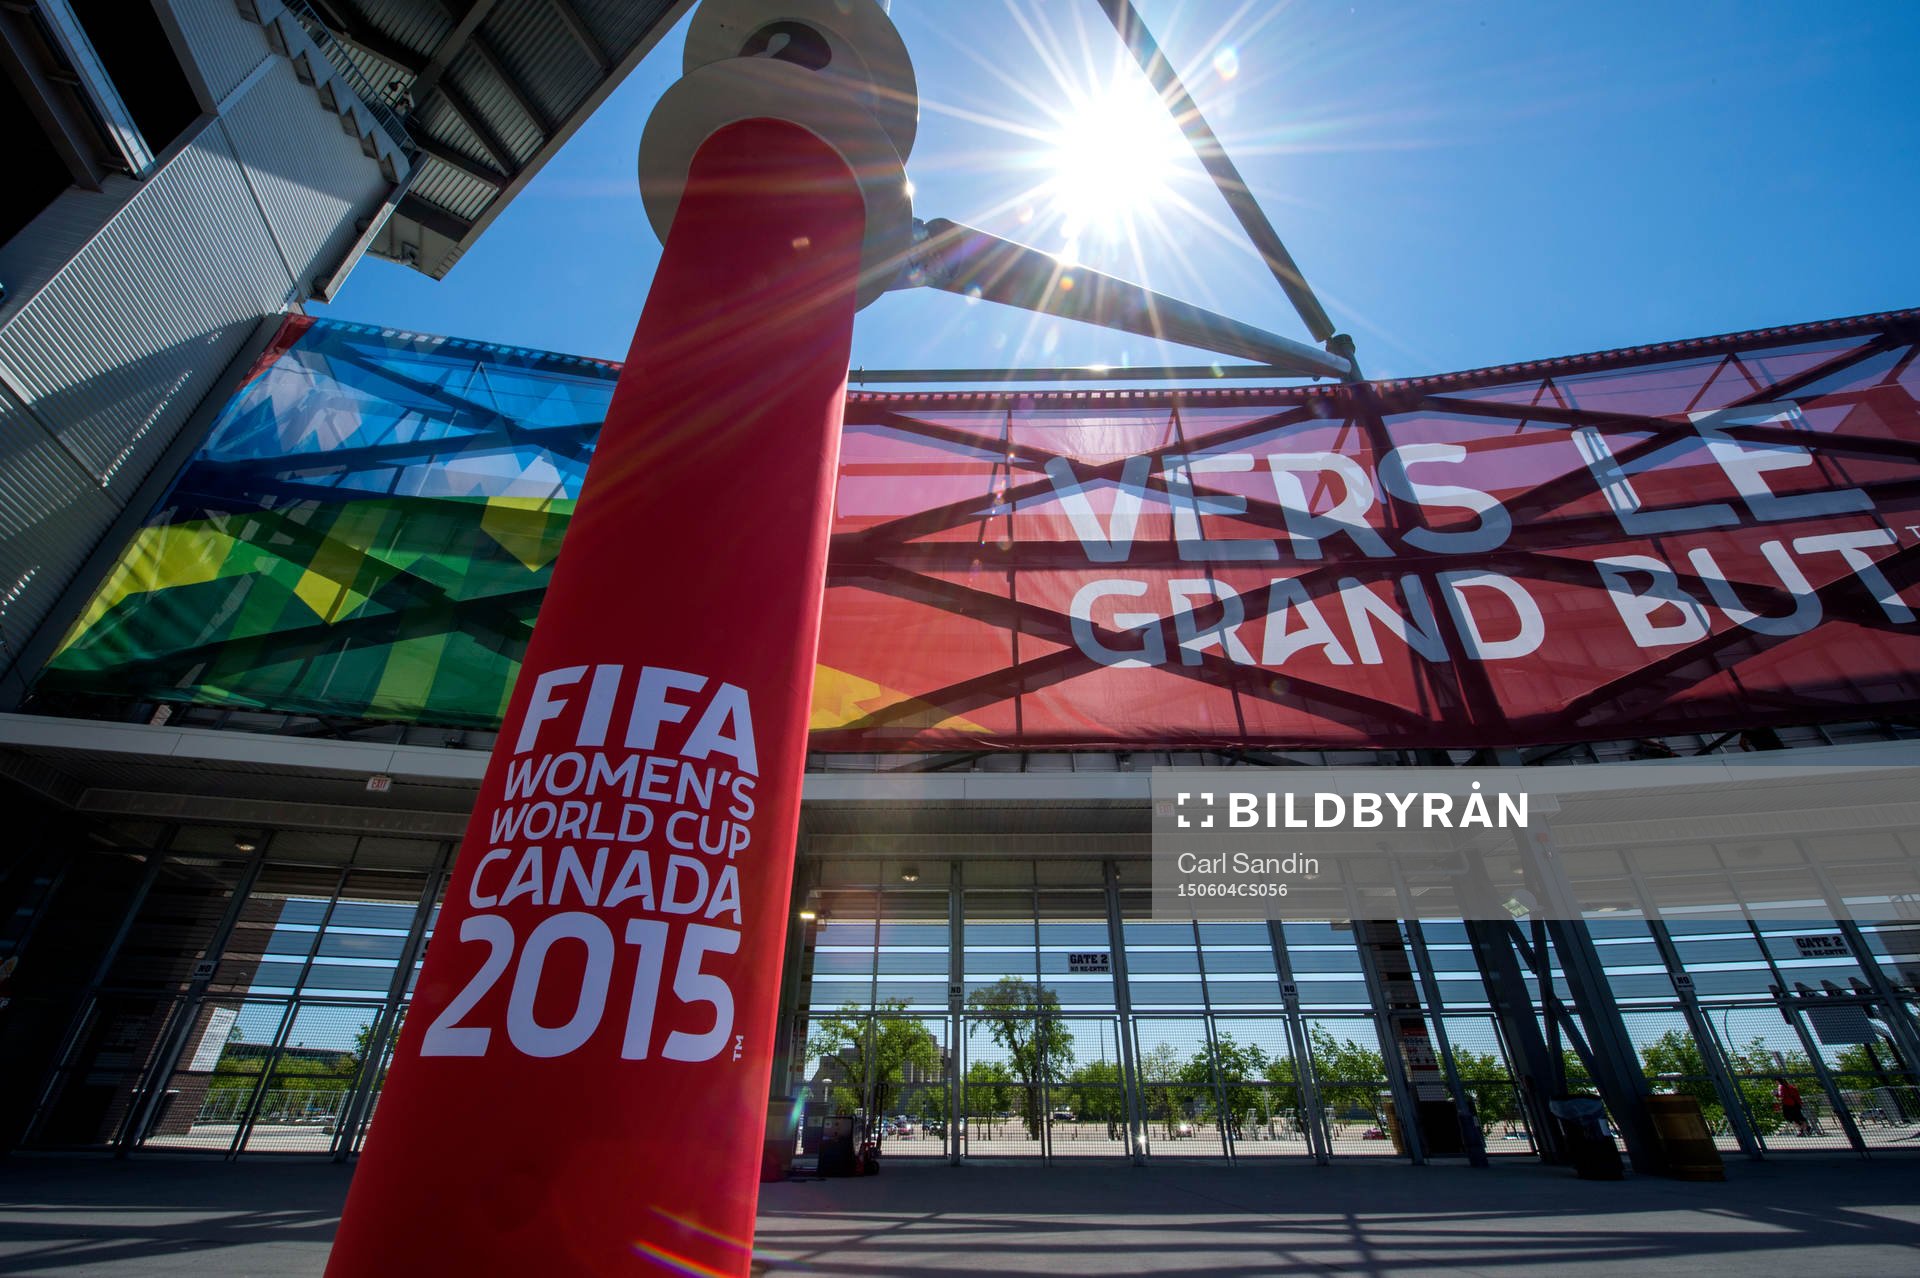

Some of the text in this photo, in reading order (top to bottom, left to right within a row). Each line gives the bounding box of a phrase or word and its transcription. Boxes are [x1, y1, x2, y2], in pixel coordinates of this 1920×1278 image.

[1045, 400, 1875, 563] VERS LE
[1069, 527, 1919, 669] GRAND BUT
[513, 663, 759, 778] FIFA
[504, 752, 756, 821] WOMEN'S
[489, 801, 752, 859] WORLD CUP
[468, 845, 743, 926] CANADA
[1070, 953, 1109, 965] GATE 2
[1796, 936, 1844, 948] GATE 2
[419, 911, 742, 1063] 2015
